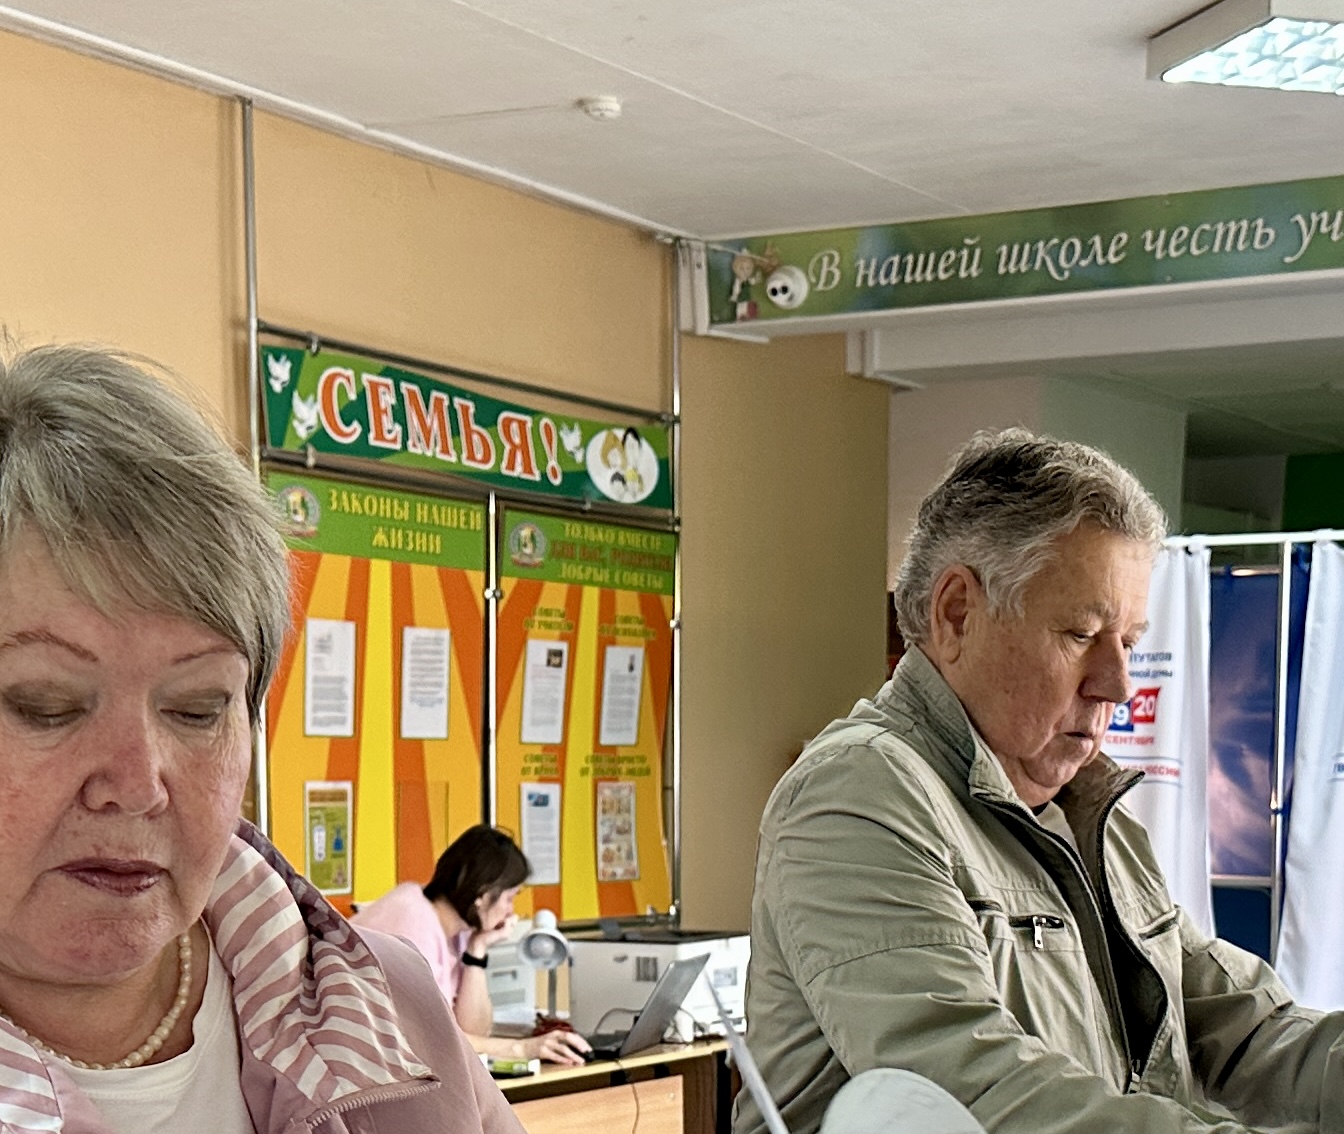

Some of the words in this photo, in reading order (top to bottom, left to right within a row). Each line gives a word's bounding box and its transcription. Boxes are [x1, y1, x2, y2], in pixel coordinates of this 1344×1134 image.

[807, 248, 843, 293] В
[855, 235, 983, 288] нашей
[997, 233, 1127, 282] школе
[1143, 216, 1275, 261] честь
[318, 367, 562, 486] СЕМЬЯ!
[329, 488, 410, 521] ЗАКОНЫ
[416, 502, 482, 531] НАШЕЙ
[372, 526, 442, 554] ЖИЗНИ
[1133, 694, 1156, 717] 20
